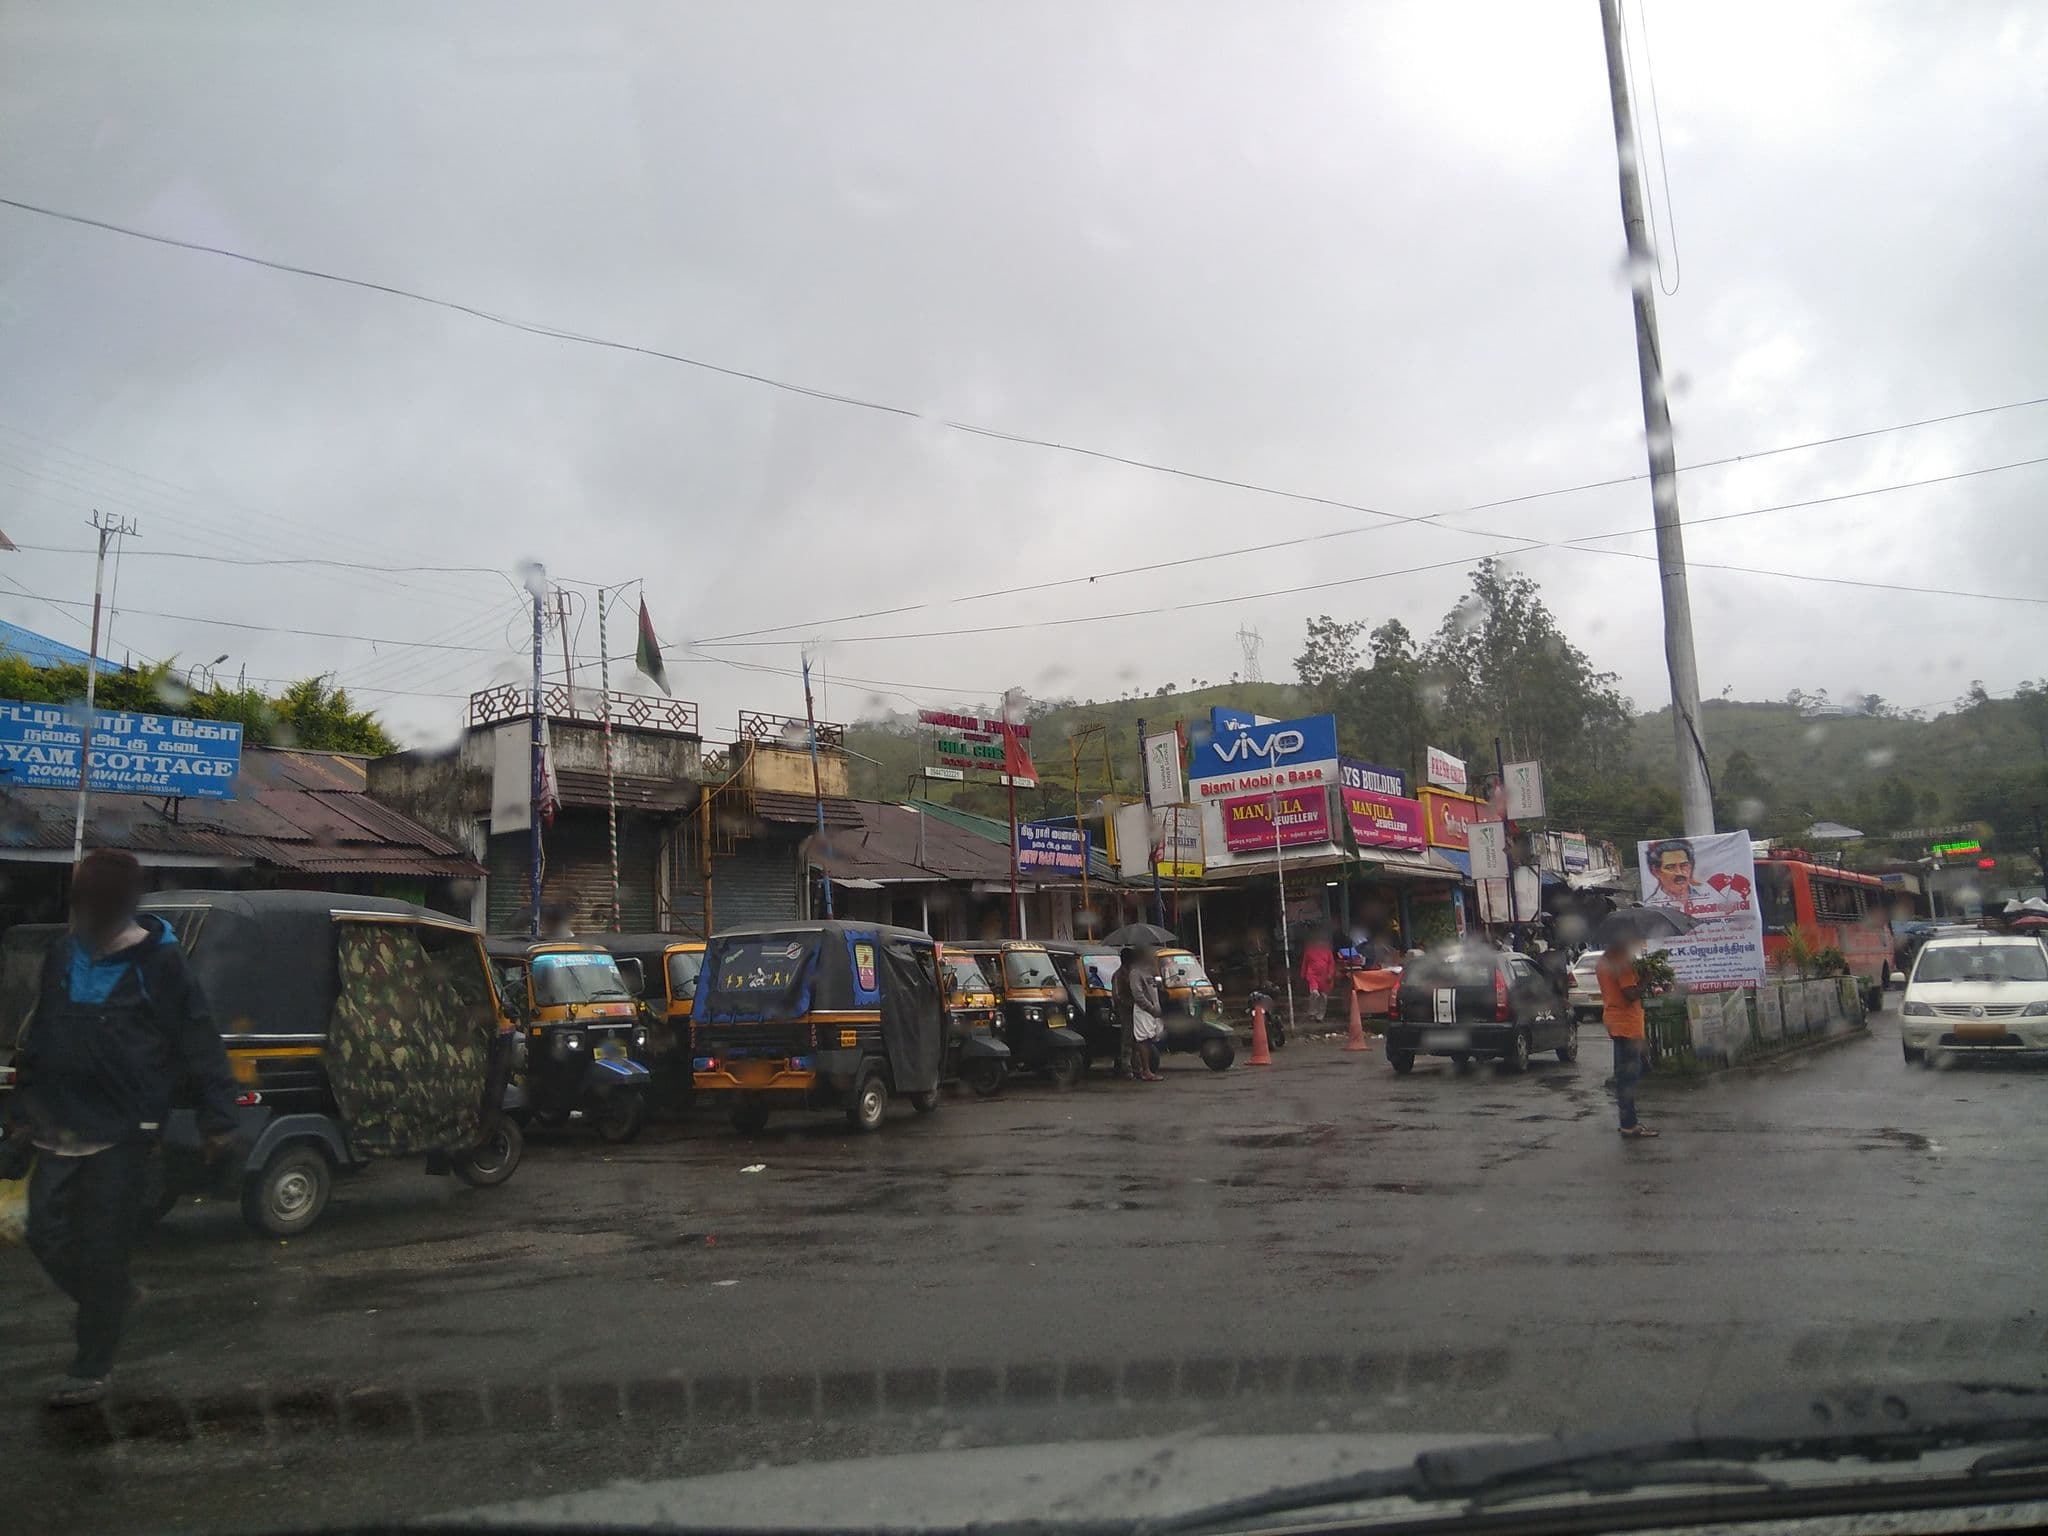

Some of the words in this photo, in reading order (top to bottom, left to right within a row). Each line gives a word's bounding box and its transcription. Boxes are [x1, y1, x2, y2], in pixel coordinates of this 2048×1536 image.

[140, 716, 165, 735] &
[172, 719, 239, 741] கோ
[23, 728, 80, 744] நகை
[91, 733, 147, 753] அடகு
[158, 740, 205, 755] கடை
[1213, 731, 1304, 762] vivo
[0, 744, 76, 766] YAM
[87, 751, 233, 777] COTTAGE
[28, 764, 82, 779] ROOM
[89, 769, 170, 785] AVAILABLE
[1200, 778, 1235, 797] Bismi
[1239, 772, 1284, 791] Mobie
[1288, 767, 1322, 784] Base
[1339, 766, 1361, 789] YS
[1361, 769, 1402, 797] BUILDING
[1271, 811, 1319, 827] JEWELLERY
[1352, 799, 1394, 822] MANJULA
[1375, 818, 1408, 833] JEWELLERY
[1167, 836, 1197, 849] JEELLERY
[1056, 852, 1083, 868] FINANC
